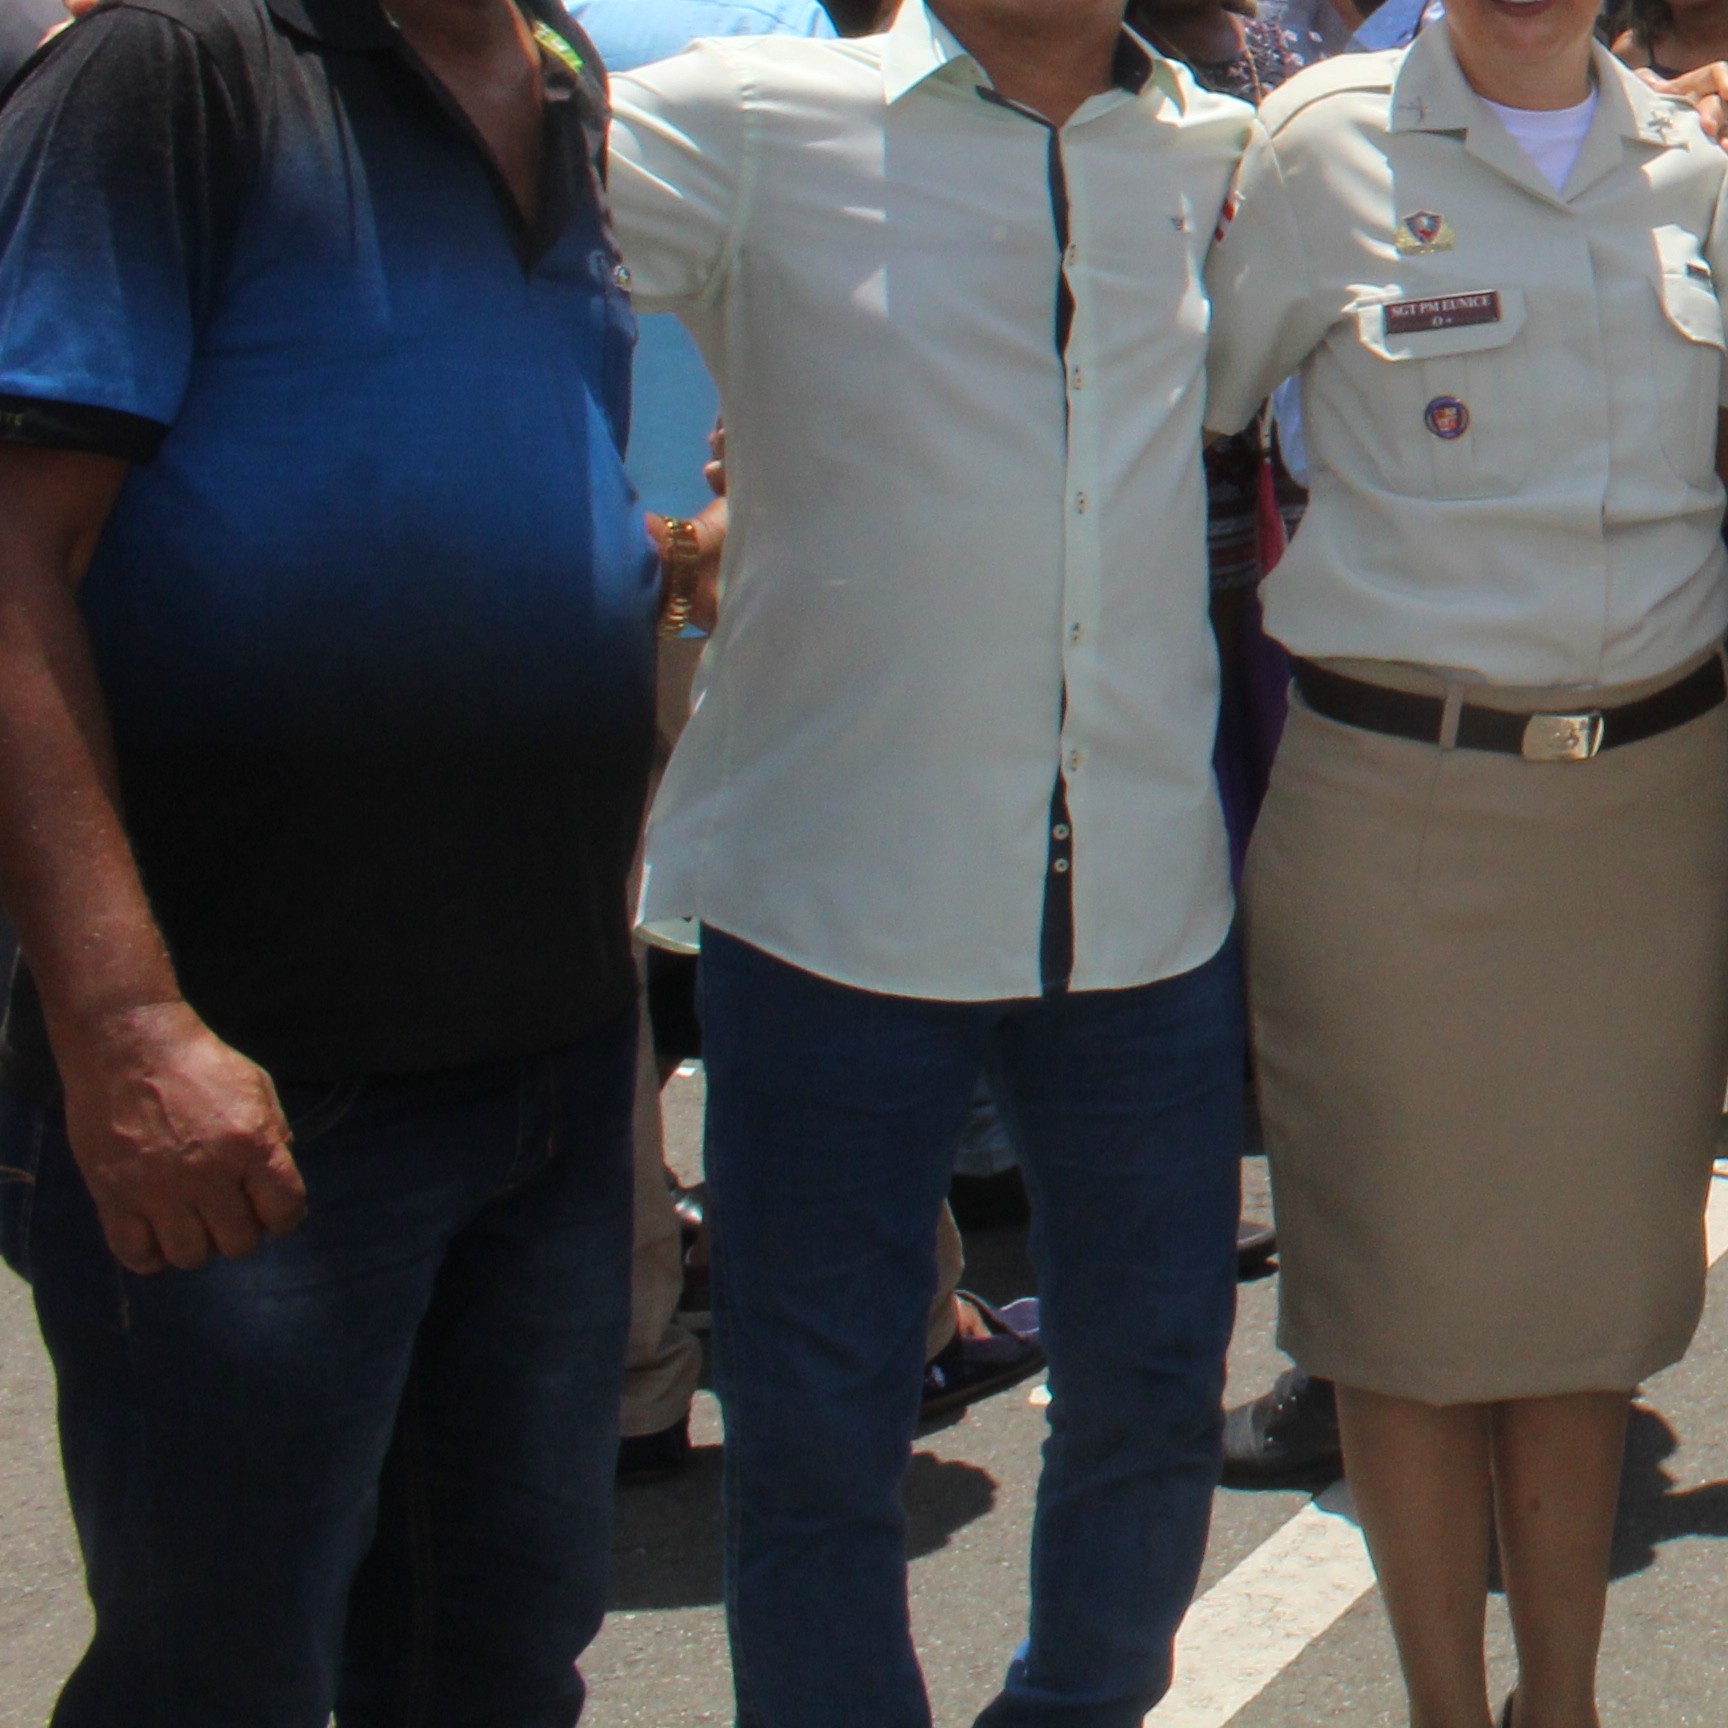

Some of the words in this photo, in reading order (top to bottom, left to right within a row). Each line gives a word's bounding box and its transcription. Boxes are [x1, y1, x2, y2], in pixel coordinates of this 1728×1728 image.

[1392, 303, 1417, 315] SGT
[1420, 301, 1440, 314] PM
[1441, 294, 1492, 311] EUNICE
